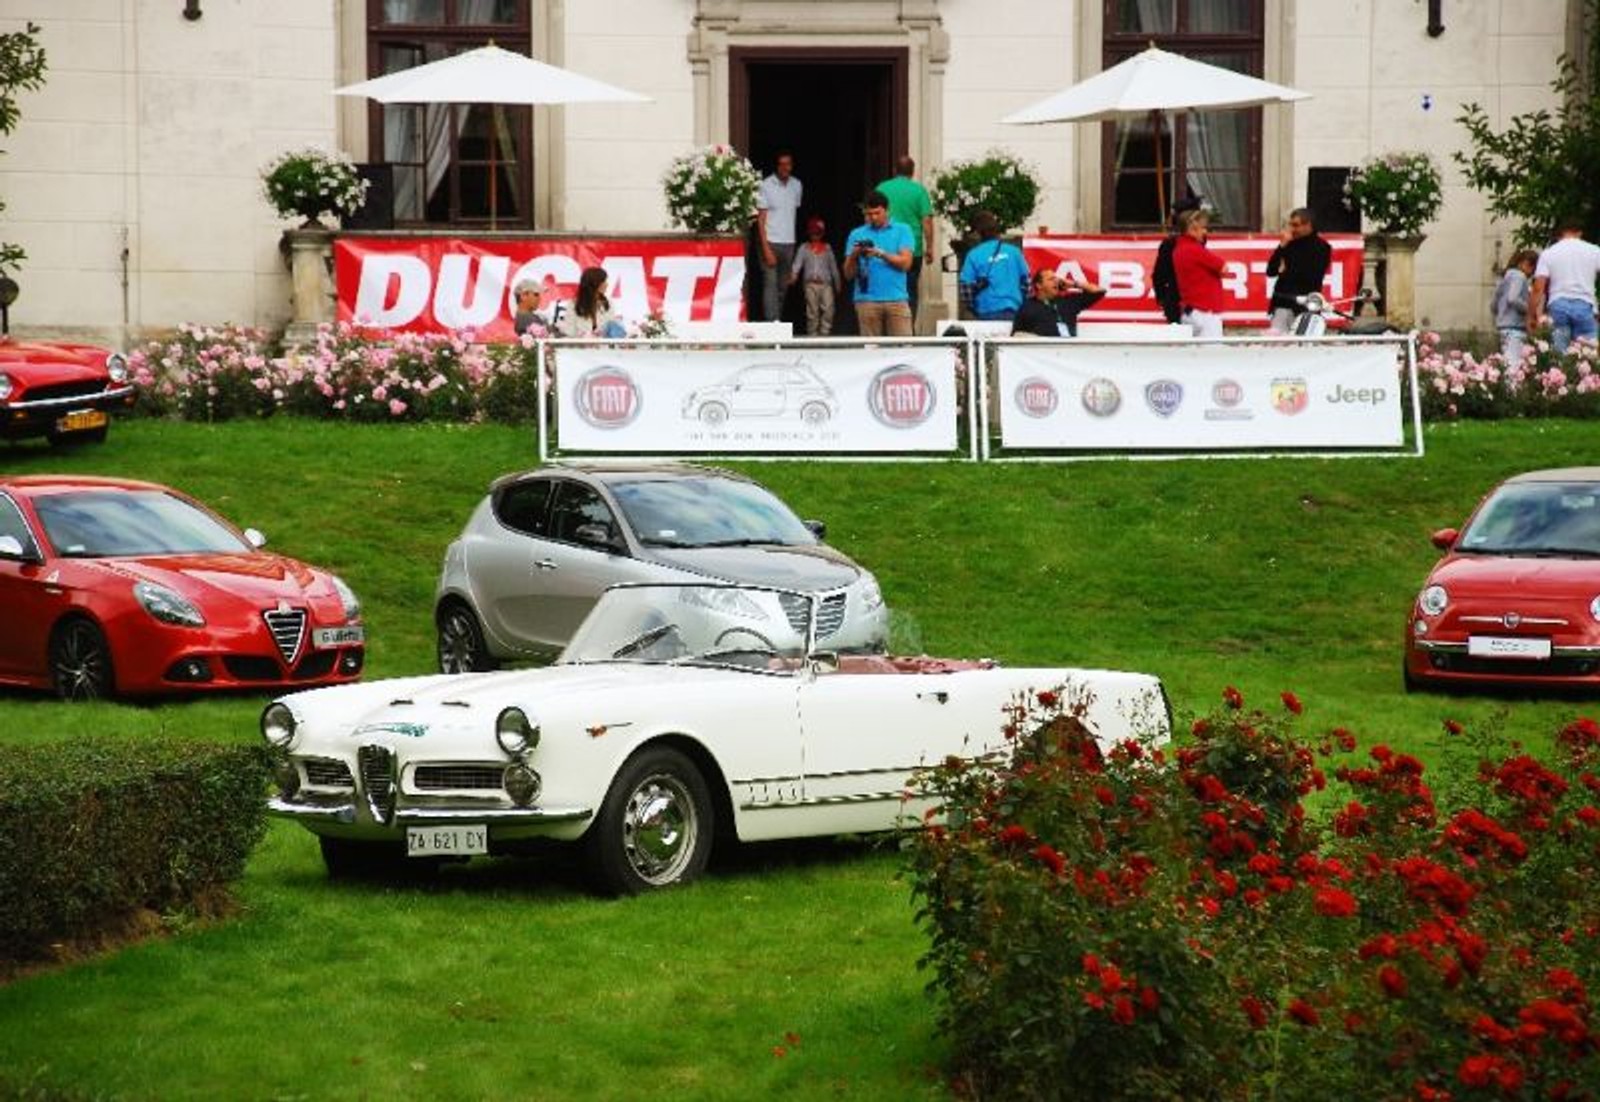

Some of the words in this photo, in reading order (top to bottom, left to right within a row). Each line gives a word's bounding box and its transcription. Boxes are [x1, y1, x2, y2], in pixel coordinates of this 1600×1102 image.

[354, 254, 747, 329] DUCATI
[1055, 261, 1344, 299] ABRTH
[592, 386, 629, 413] FIAT
[886, 384, 922, 412] FIAT
[1326, 384, 1386, 405] Jeep
